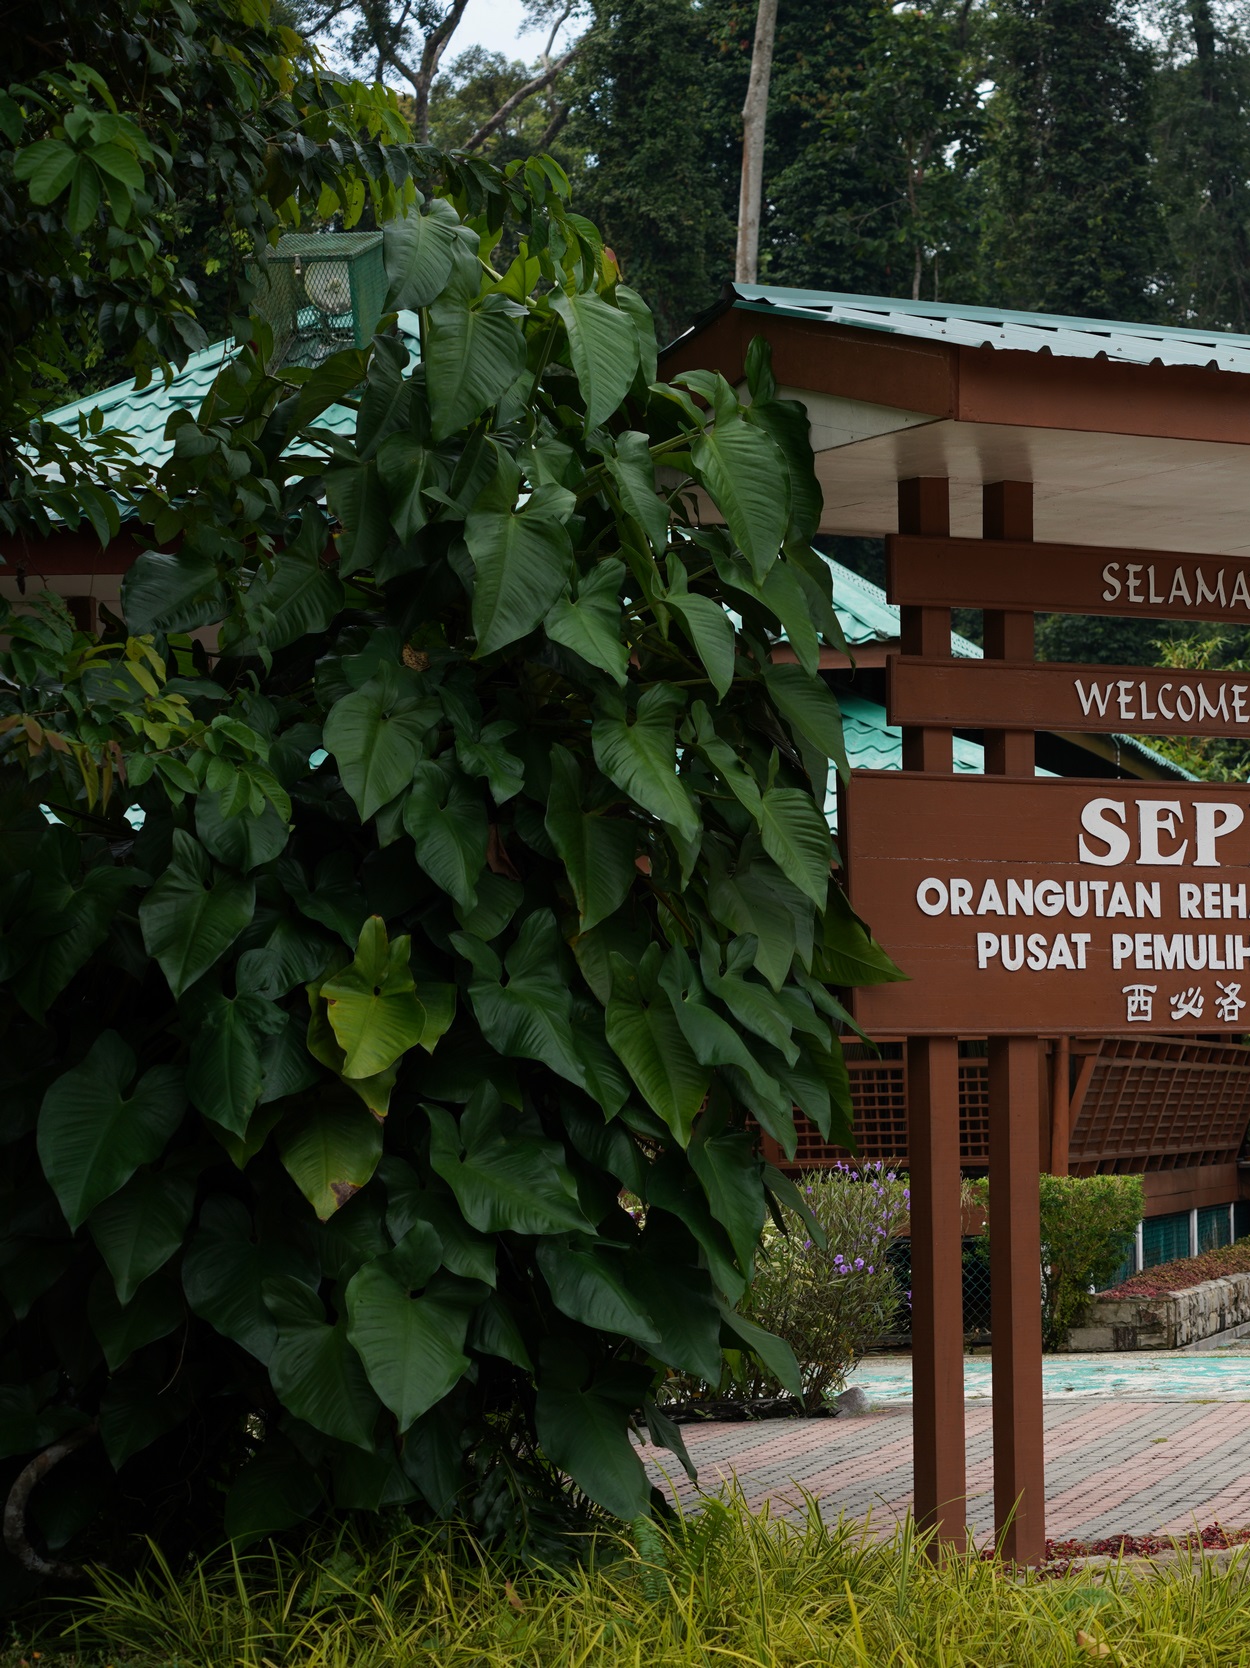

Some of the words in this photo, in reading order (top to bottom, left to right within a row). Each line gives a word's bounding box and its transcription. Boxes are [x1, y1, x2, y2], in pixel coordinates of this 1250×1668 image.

[1074, 679, 1250, 724] WELCOME
[915, 877, 1162, 918] ORANGUTAN
[976, 932, 1092, 972] PUSAT
